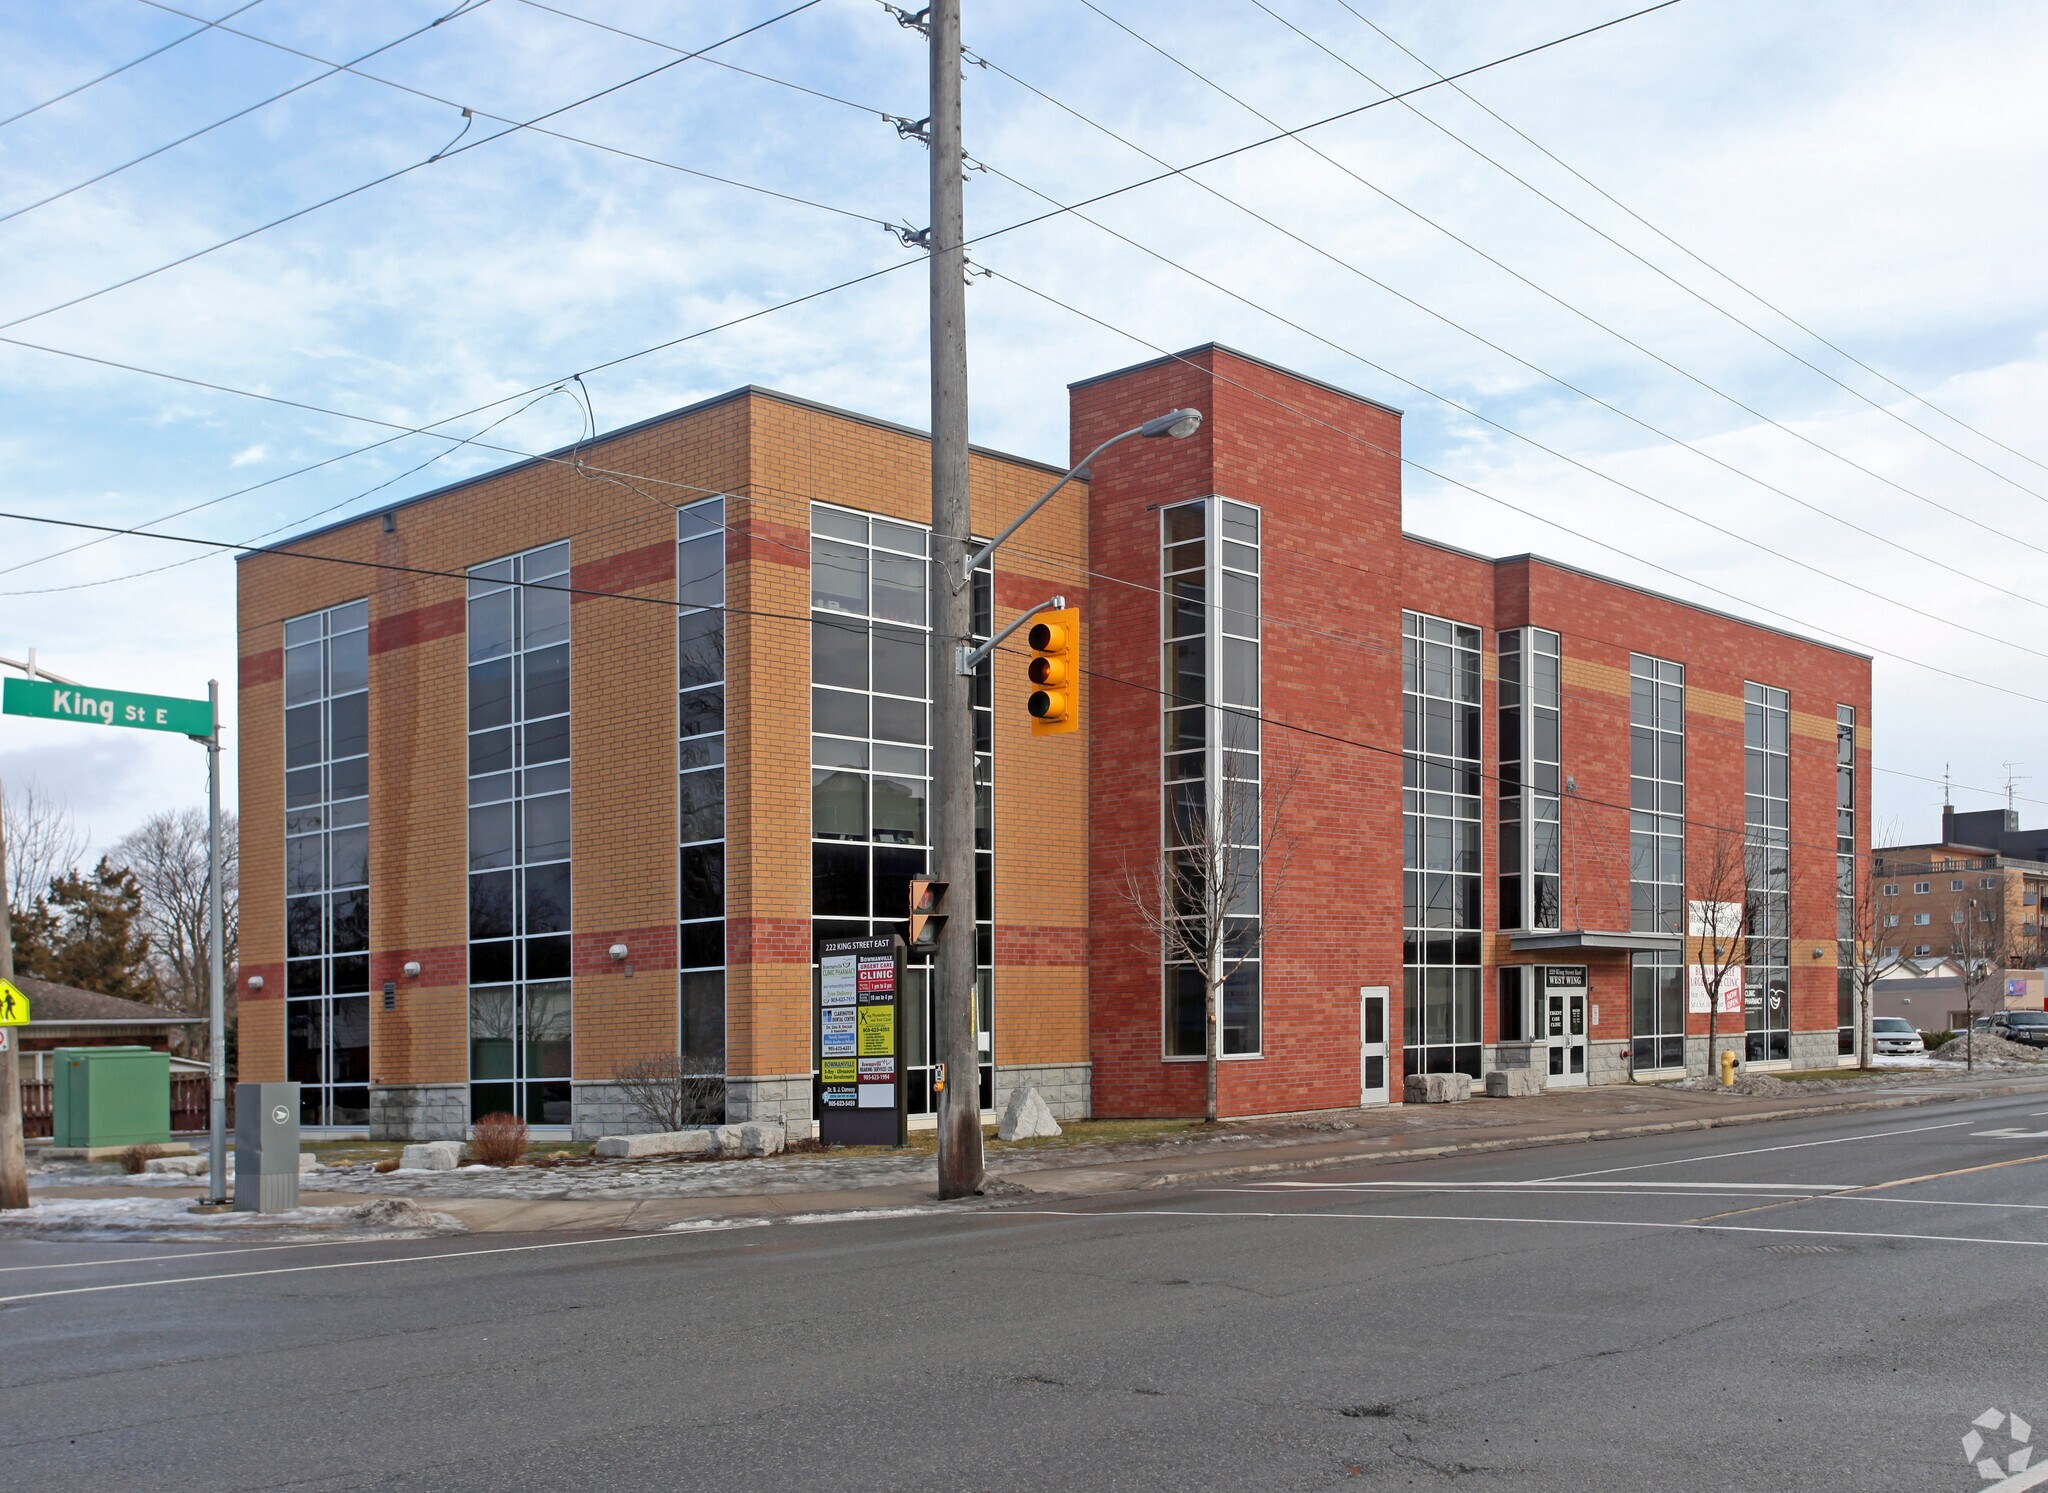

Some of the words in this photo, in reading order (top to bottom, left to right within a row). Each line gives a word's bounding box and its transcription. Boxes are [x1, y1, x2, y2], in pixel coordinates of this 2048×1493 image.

[53, 690, 114, 725] King
[125, 705, 146, 722] St
[156, 708, 168, 724] E
[852, 941, 873, 949] STREET
[860, 970, 893, 980] CLINIC
[1549, 976, 1565, 984] WEST
[1566, 976, 1581, 984] WING
[1727, 991, 1737, 999] NOW
[1727, 999, 1738, 1008] OPEN
